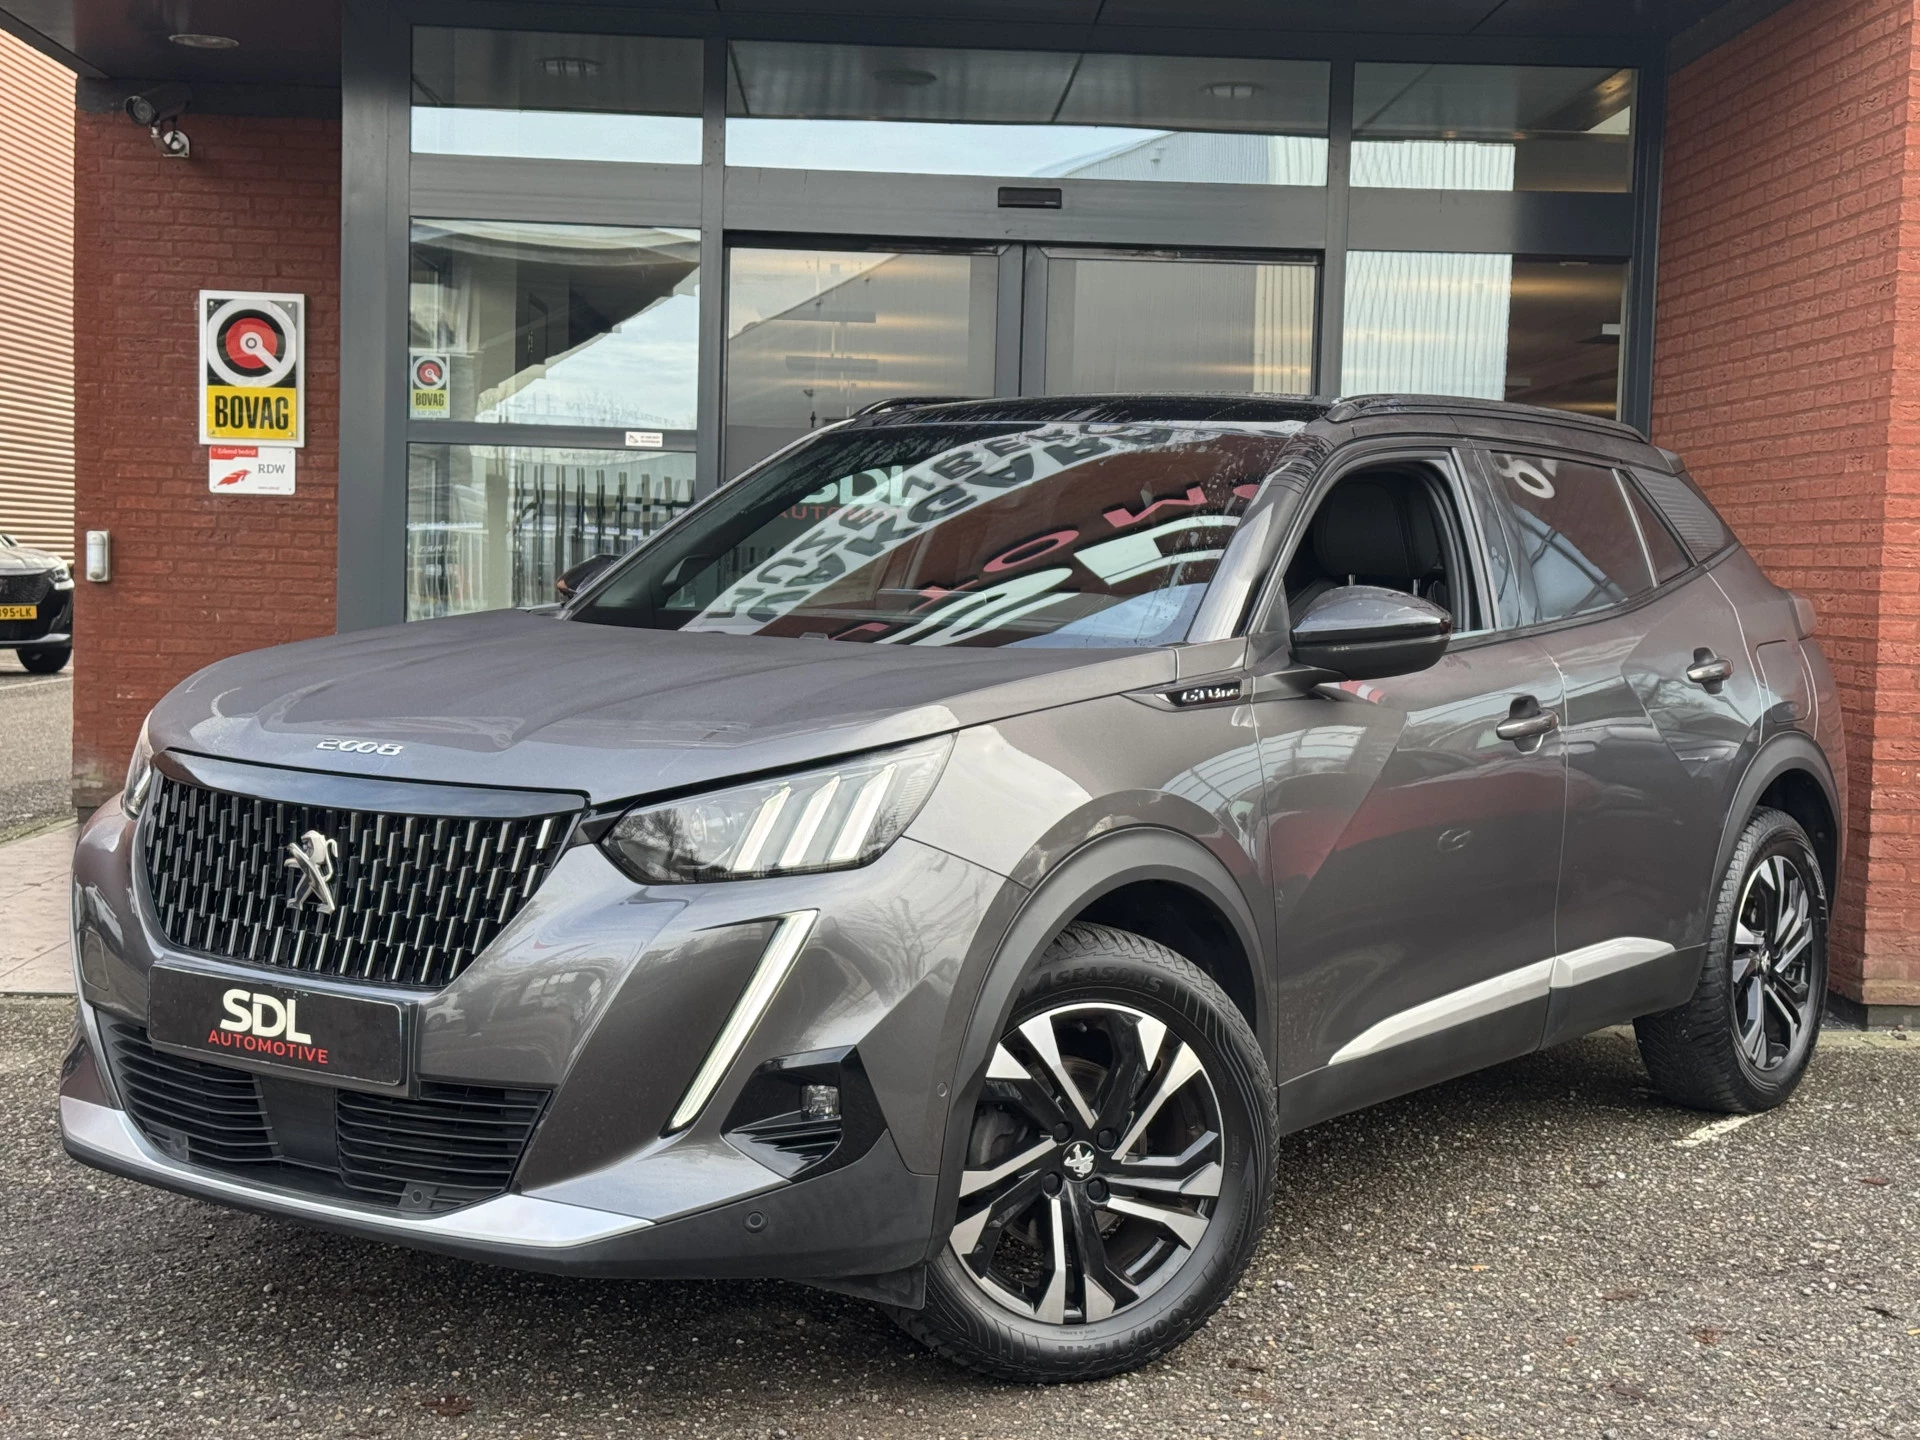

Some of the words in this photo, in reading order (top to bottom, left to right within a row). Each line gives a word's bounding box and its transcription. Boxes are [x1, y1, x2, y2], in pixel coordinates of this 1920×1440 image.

[416, 393, 445, 406] BOVAG
[214, 395, 289, 430] BOVAG
[258, 464, 285, 474] RDW
[0, 607, 32, 617] 95-LK
[316, 738, 404, 756] 2008
[220, 988, 312, 1045] SDL
[208, 1029, 329, 1065] AUTOMOTIVE
